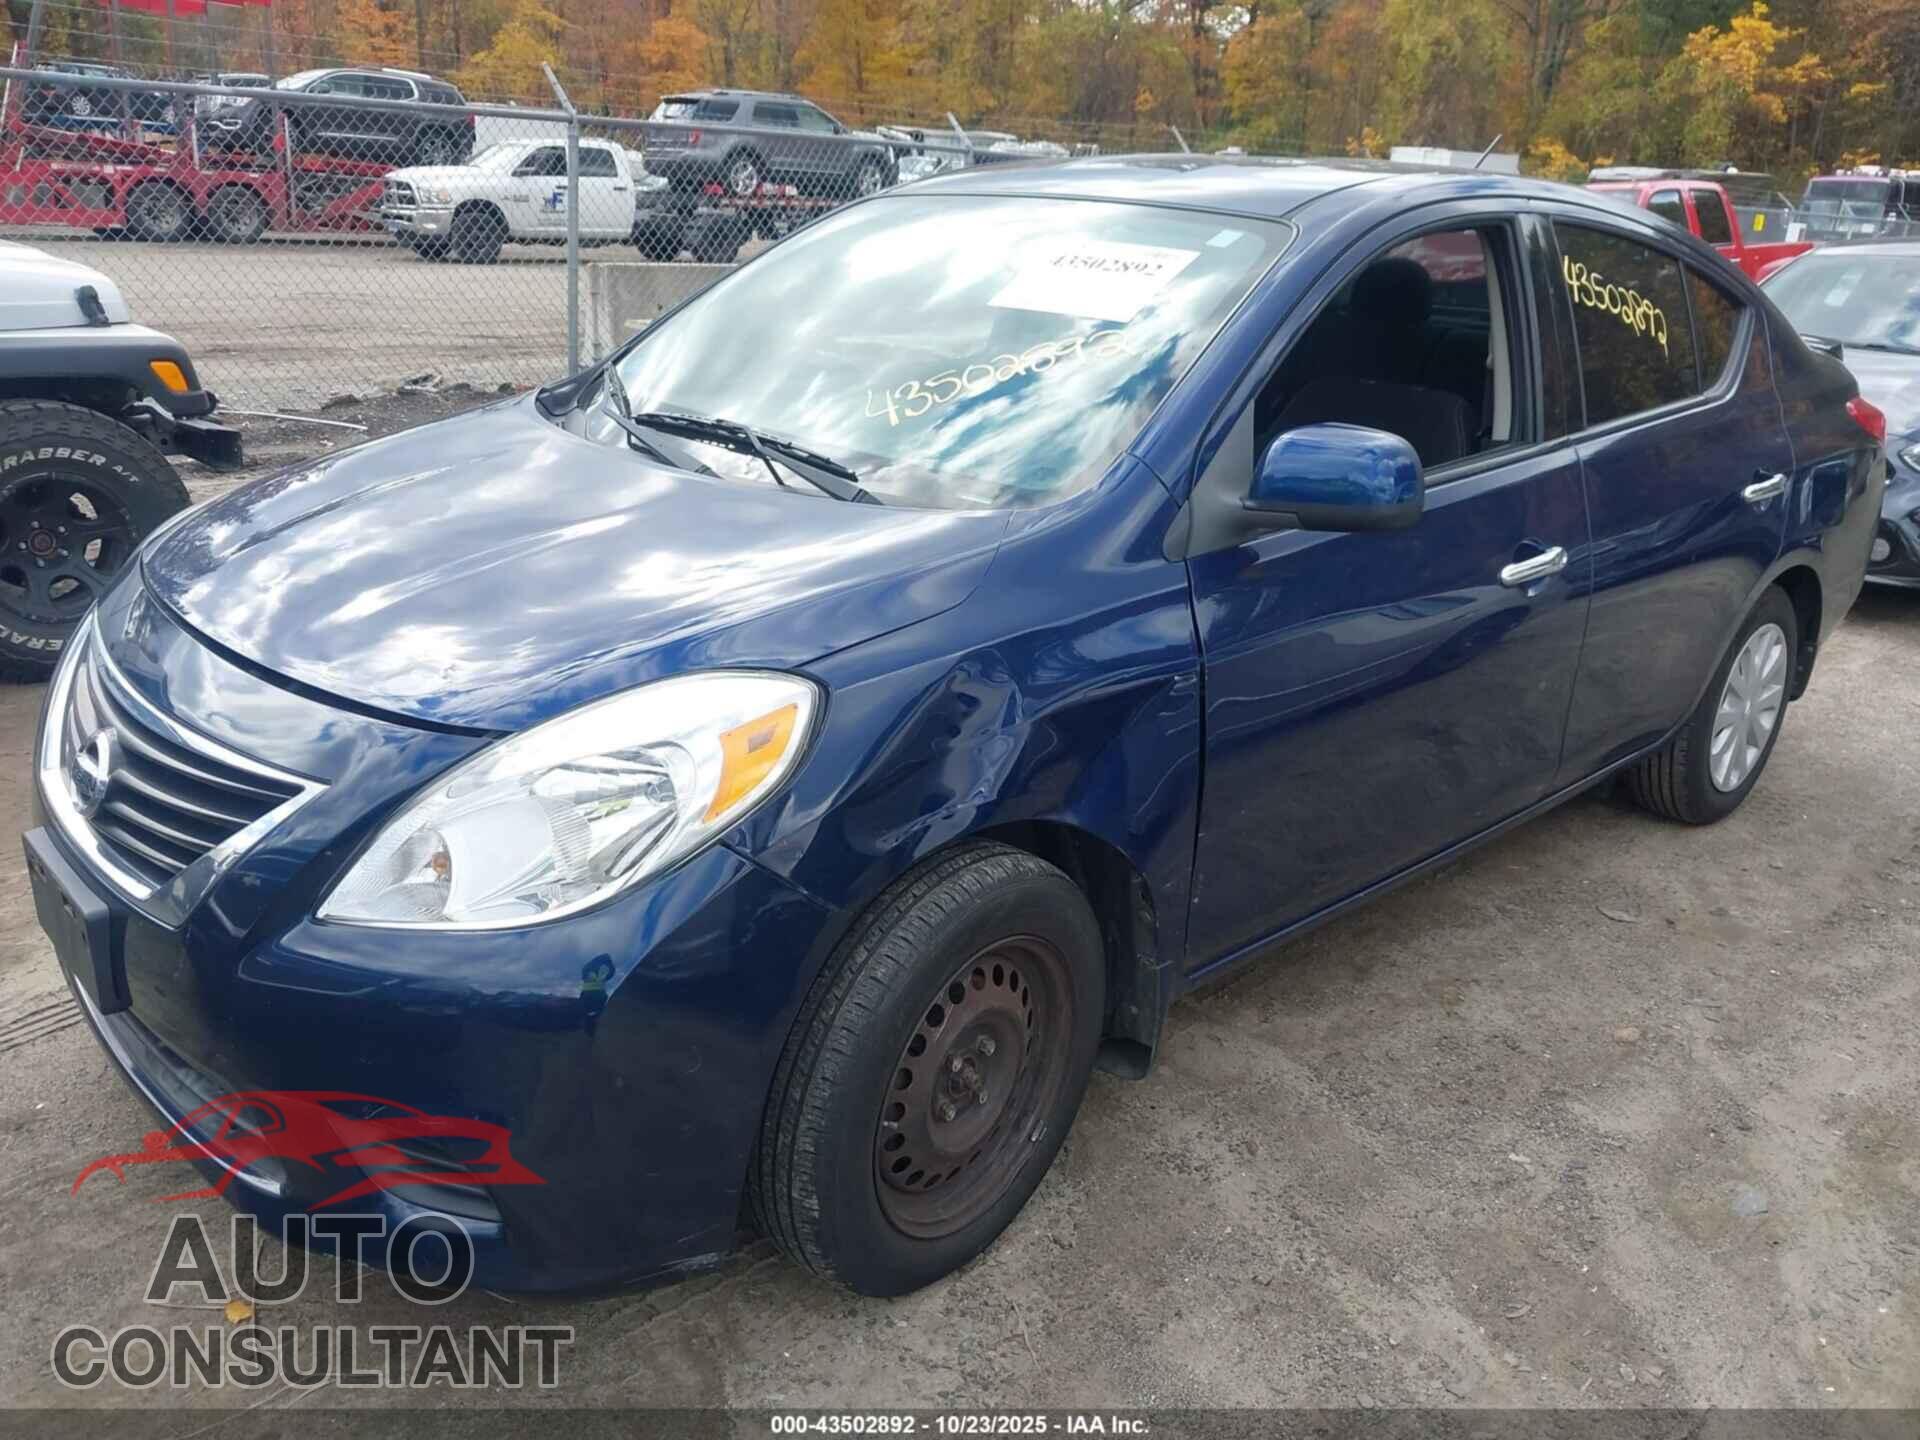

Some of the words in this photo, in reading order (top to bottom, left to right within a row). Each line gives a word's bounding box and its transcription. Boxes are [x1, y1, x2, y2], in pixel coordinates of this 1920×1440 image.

[1563, 255, 1668, 360] 43502892
[864, 329, 1129, 426] 43502892
[0, 447, 107, 472] RABBER
